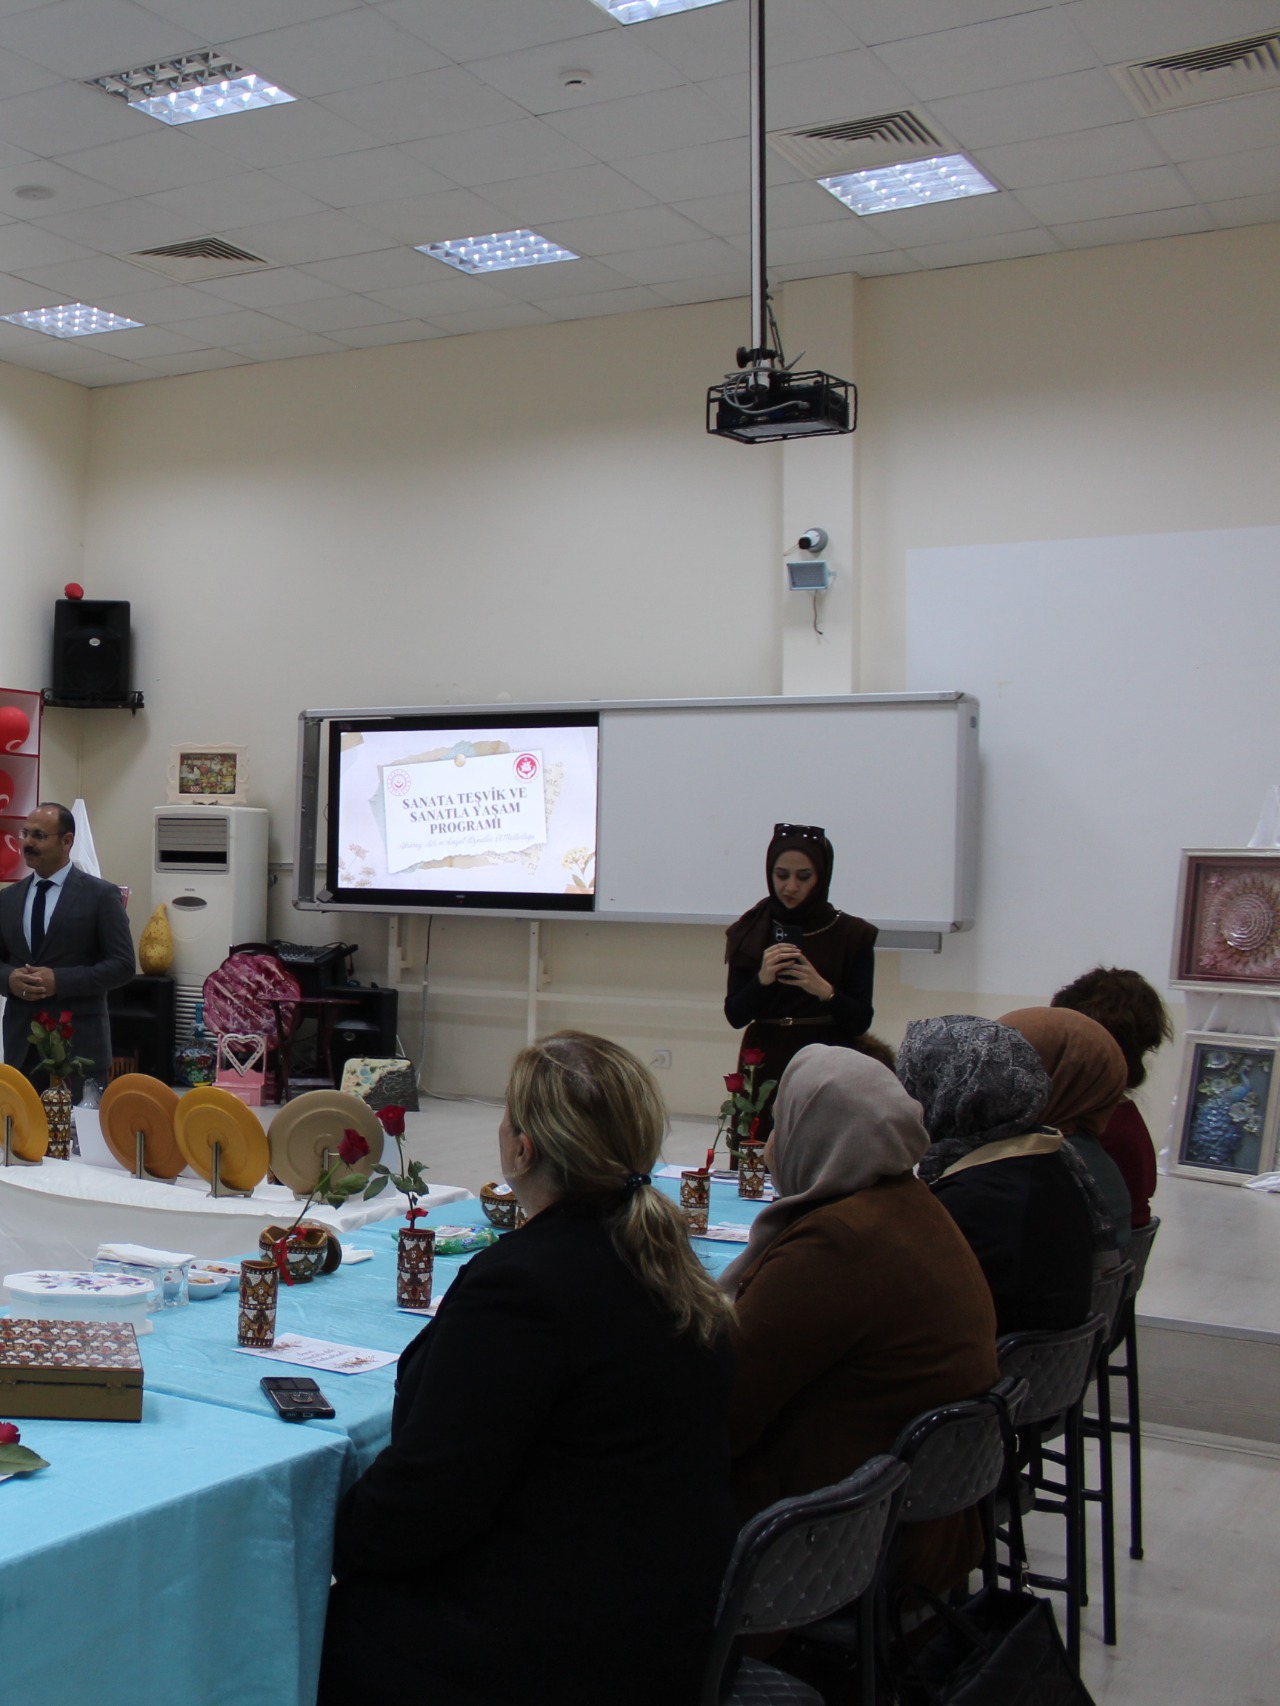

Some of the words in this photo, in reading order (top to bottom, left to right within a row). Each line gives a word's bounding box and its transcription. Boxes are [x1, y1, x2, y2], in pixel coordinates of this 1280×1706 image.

[402, 795, 454, 810] SANATA
[457, 787, 506, 807] TEŞVİK
[510, 787, 528, 799] VE
[410, 808, 470, 823] SANATLA
[473, 802, 521, 819] YAŞAM
[430, 818, 501, 834] PROGRAMI
